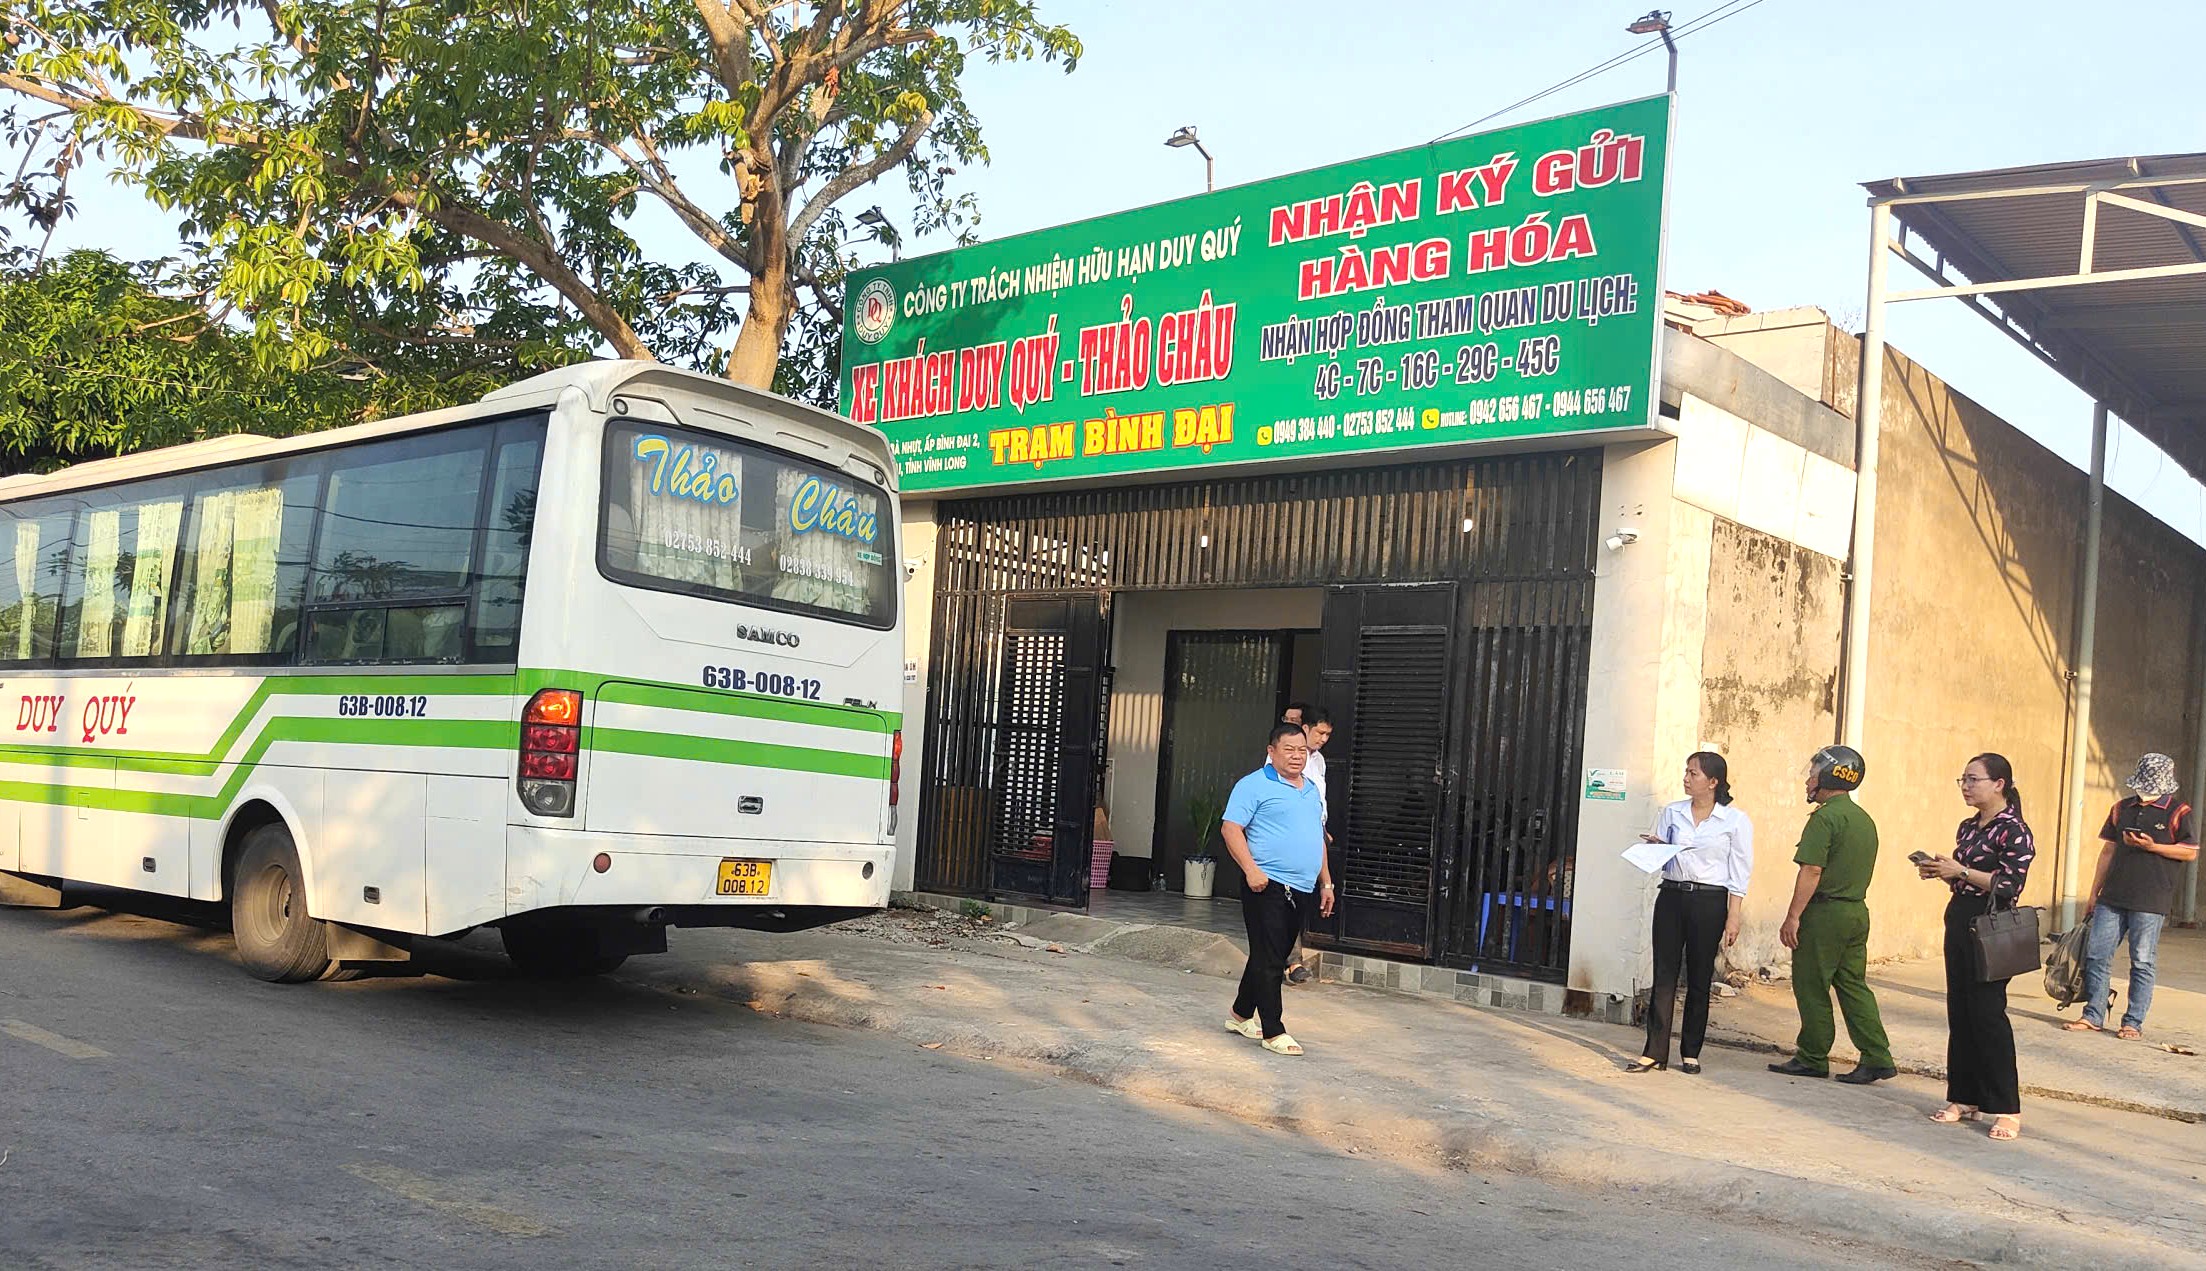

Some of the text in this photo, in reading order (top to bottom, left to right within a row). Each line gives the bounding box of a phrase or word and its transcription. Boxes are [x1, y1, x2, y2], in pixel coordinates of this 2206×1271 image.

[1268, 128, 1645, 245] NHẬN KÝ GỬI
[903, 215, 1242, 318] CÔNG TY TRÁCH NHIỆM HỮU HẠN DUY QUÝ
[1298, 211, 1597, 300] HÀNG HÓA
[1260, 274, 1637, 365] NHẬN HỢP ĐỒNG THAM QUAN DU LỊCH:
[850, 289, 1237, 425] XE KHÁCH DUY QUÝ - THẢO CHÂU
[1315, 335, 1560, 400] 4C - 7C - 16C - 29C - 45C
[1274, 419, 1296, 444] 0949
[1298, 417, 1315, 442] 384
[1317, 415, 1335, 440] 440
[1343, 411, 1373, 437] 02753
[1375, 408, 1393, 434] 852
[1396, 406, 1414, 432] 444
[1469, 399, 1496, 425] 0942
[1499, 396, 1519, 423] 656
[1521, 393, 1543, 420] 467
[1552, 390, 1581, 417] 0944
[1583, 387, 1605, 415] 656
[1608, 386, 1631, 413] 467
[924, 433, 935, 452] ẤP
[936, 434, 955, 451] BÌNH
[956, 434, 972, 451] ĐẠI
[988, 402, 1235, 470] TRẠM BÌNH ĐẠI
[905, 457, 922, 474] TỈNH
[924, 456, 942, 472] VĨNH
[944, 455, 967, 471] LONG
[635, 435, 877, 543] Thảo Châu
[664, 529, 752, 566] 02753 852 444
[736, 623, 800, 648] SAMCO
[702, 665, 822, 701] 63B-008.12
[16, 681, 136, 744] DUY QUÝ
[338, 695, 428, 718] 63B-008.12
[723, 879, 764, 893] 008.12
[734, 863, 757, 877] 63B
